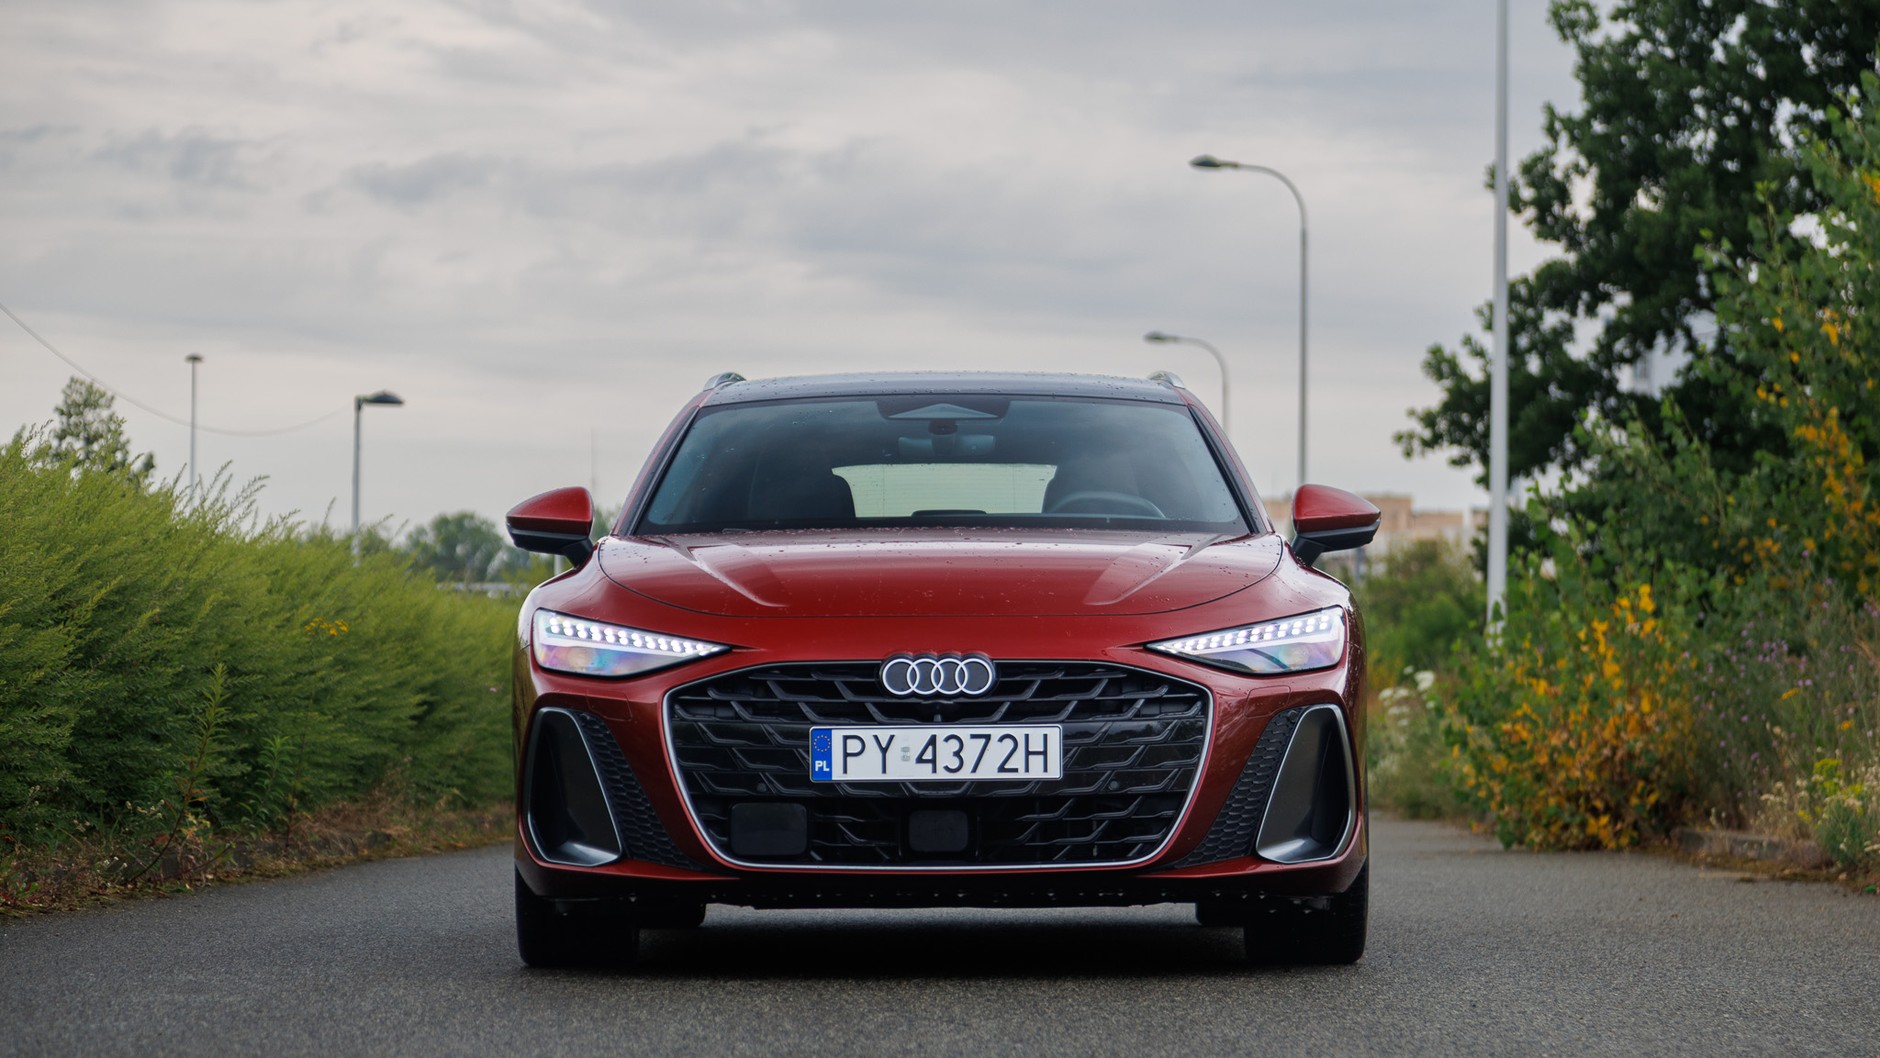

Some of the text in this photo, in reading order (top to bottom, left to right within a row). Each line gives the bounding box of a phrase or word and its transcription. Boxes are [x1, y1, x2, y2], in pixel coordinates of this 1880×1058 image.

[815, 760, 830, 772] PL
[842, 734, 1048, 774] PY 4372H
